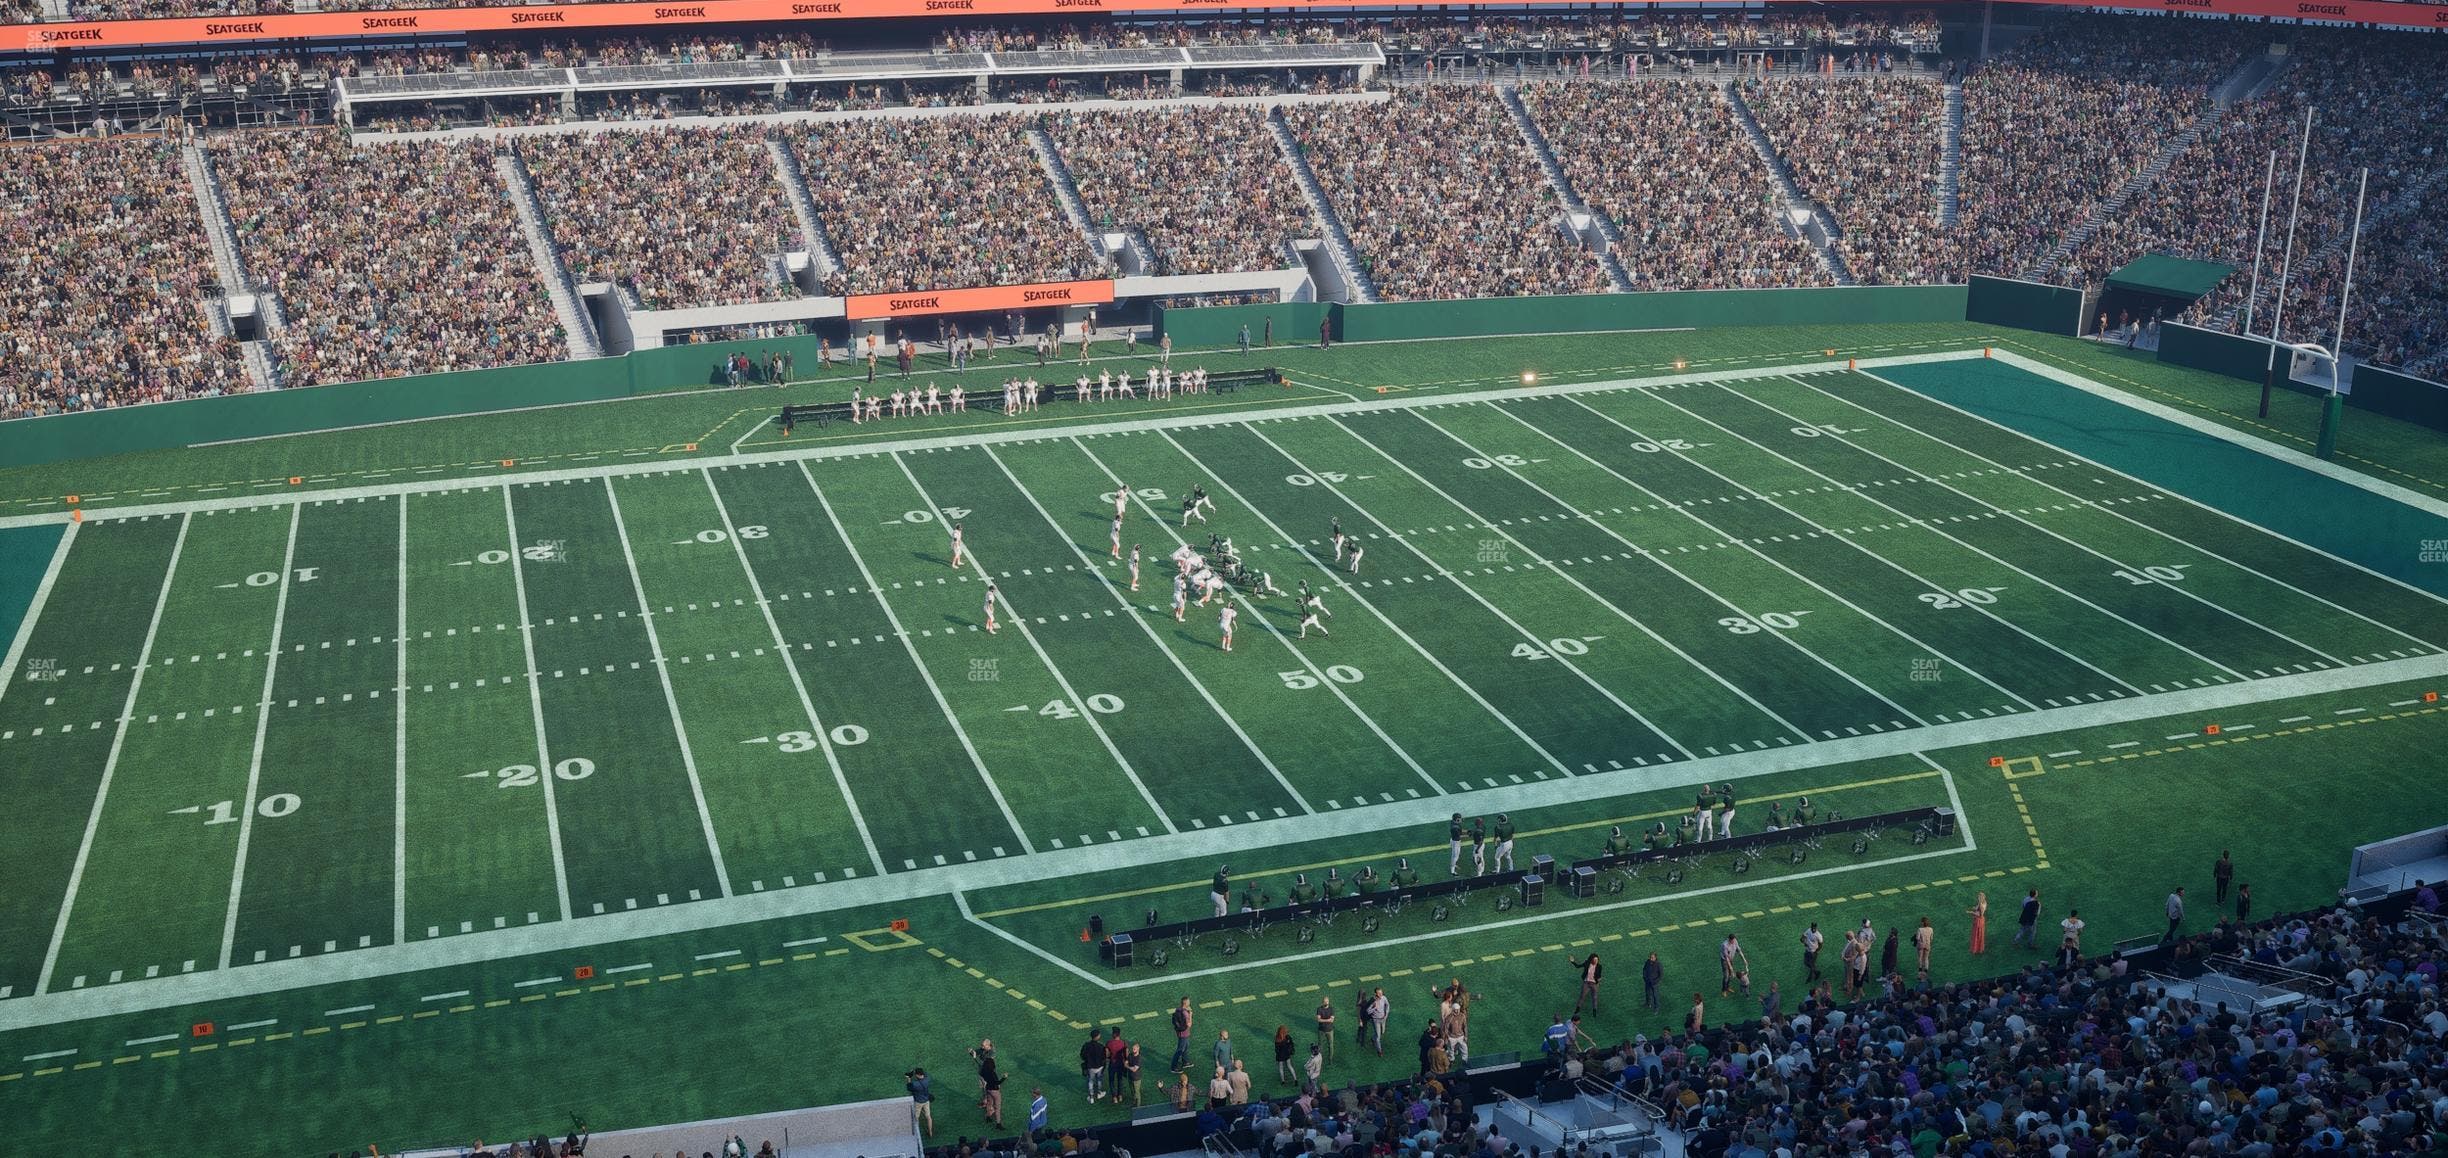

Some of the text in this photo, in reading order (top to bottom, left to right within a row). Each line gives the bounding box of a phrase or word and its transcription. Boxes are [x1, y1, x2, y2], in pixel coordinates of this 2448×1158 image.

[655, 7, 705, 19] SEATGEEK
[792, 3, 841, 14] SEATGEEK
[926, 0, 973, 11] SEATGEEK
[2297, 3, 2347, 15] SEATGEEK
[362, 16, 417, 29] SEATGEEK
[511, 11, 564, 24] SEATGEEK
[41, 29, 103, 42] SEATGEEK
[206, 22, 264, 35] SEATGEEK
[1024, 288, 1071, 301] SEATGEEK
[890, 297, 939, 311] SEATGEEK
[1790, 423, 1850, 437] 10
[1631, 438, 1695, 454] 20
[1462, 454, 1528, 470] 30
[1285, 471, 1349, 487] 40
[903, 506, 973, 524] 40
[696, 525, 770, 544] 30
[476, 546, 554, 565] 20
[245, 566, 319, 587] 10
[2111, 566, 2186, 586] 10
[1918, 588, 1998, 610] 20
[1717, 612, 1799, 635] 30
[1510, 637, 1590, 661] 40
[1278, 665, 1364, 690] 50
[1039, 693, 1125, 720] 40
[777, 724, 869, 753] 30
[496, 757, 596, 788] 20
[202, 792, 302, 826] 10
[199, 1025, 208, 1033] 10
